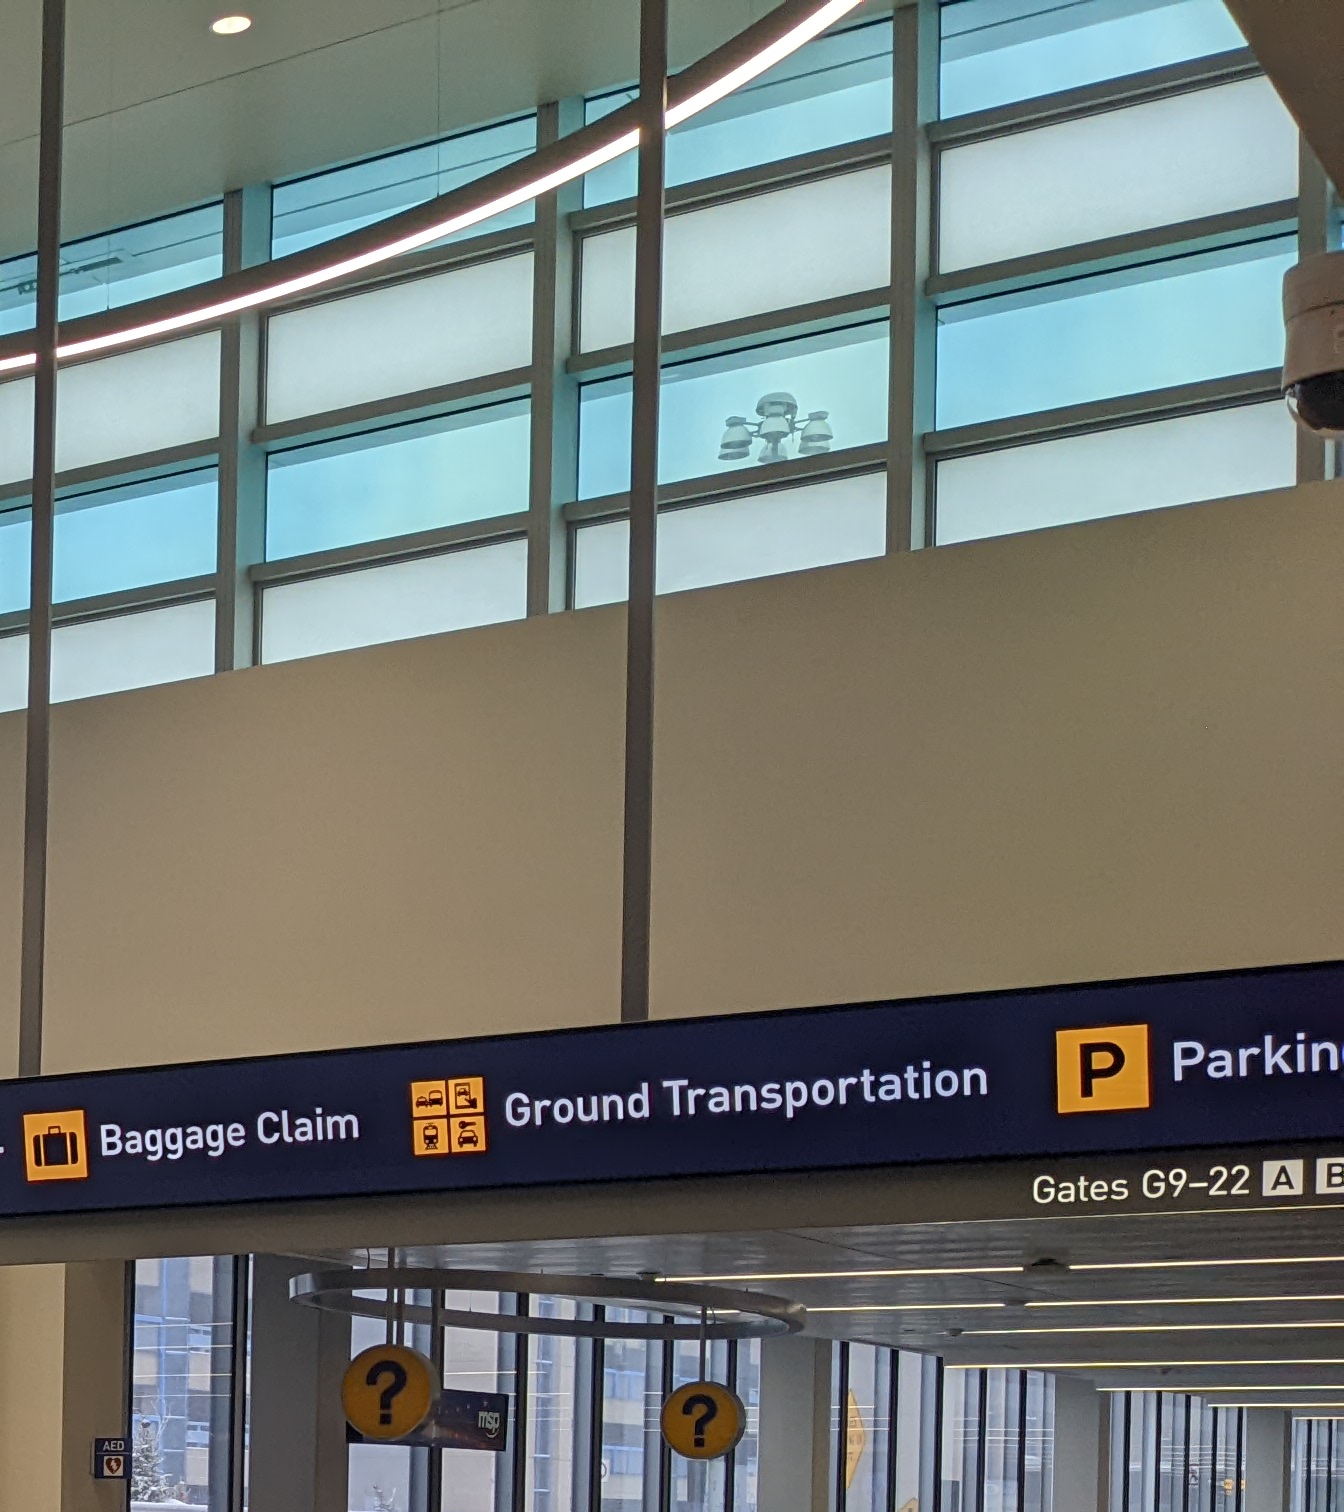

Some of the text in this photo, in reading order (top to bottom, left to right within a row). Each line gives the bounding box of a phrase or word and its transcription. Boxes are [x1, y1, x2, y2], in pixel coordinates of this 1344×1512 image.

[1079, 1041, 1126, 1098] P
[1173, 1032, 1344, 1082] Parkin
[505, 1060, 988, 1127] Ground Transportation
[100, 1107, 360, 1162] Baggage Claim
[1032, 1174, 1129, 1204] Gates
[1271, 1165, 1295, 1191] A
[103, 1440, 125, 1451] AED
[478, 1410, 500, 1434] msp
